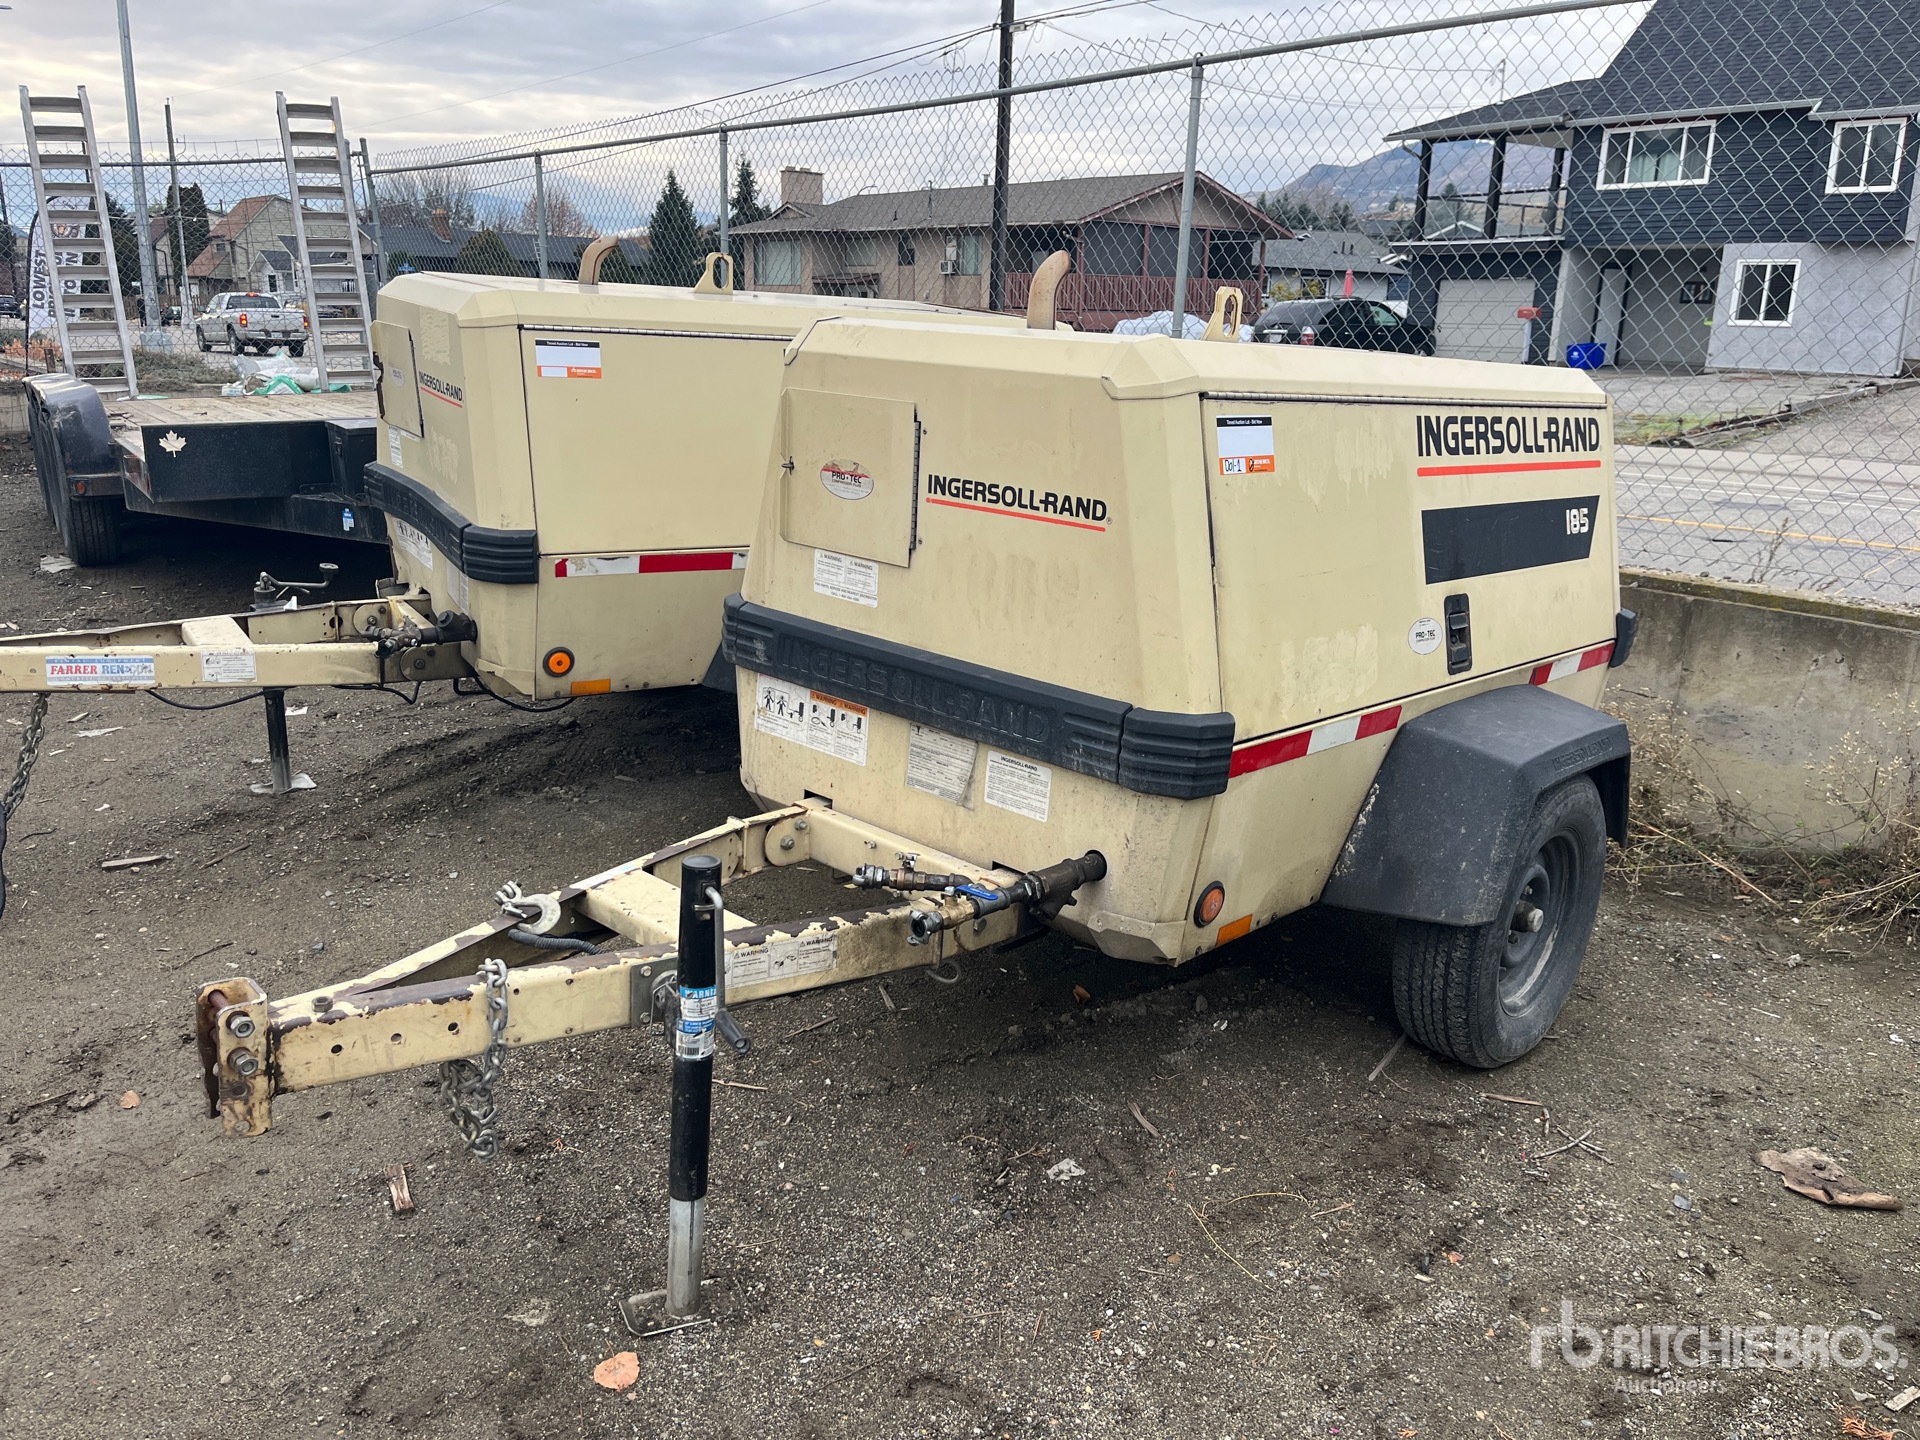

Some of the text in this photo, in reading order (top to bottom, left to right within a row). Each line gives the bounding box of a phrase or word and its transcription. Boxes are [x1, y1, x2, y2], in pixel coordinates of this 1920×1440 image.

[32, 250, 47, 309] LOWEST
[1416, 415, 1600, 457] INGERSOLL-RAND
[927, 474, 1107, 521] INGERSOLL-RAND
[1565, 507, 1589, 535] 185
[51, 664, 98, 675] FARRER
[815, 693, 837, 705] WARNING
[844, 701, 866, 714] WARNING
[740, 948, 769, 958] WARNING
